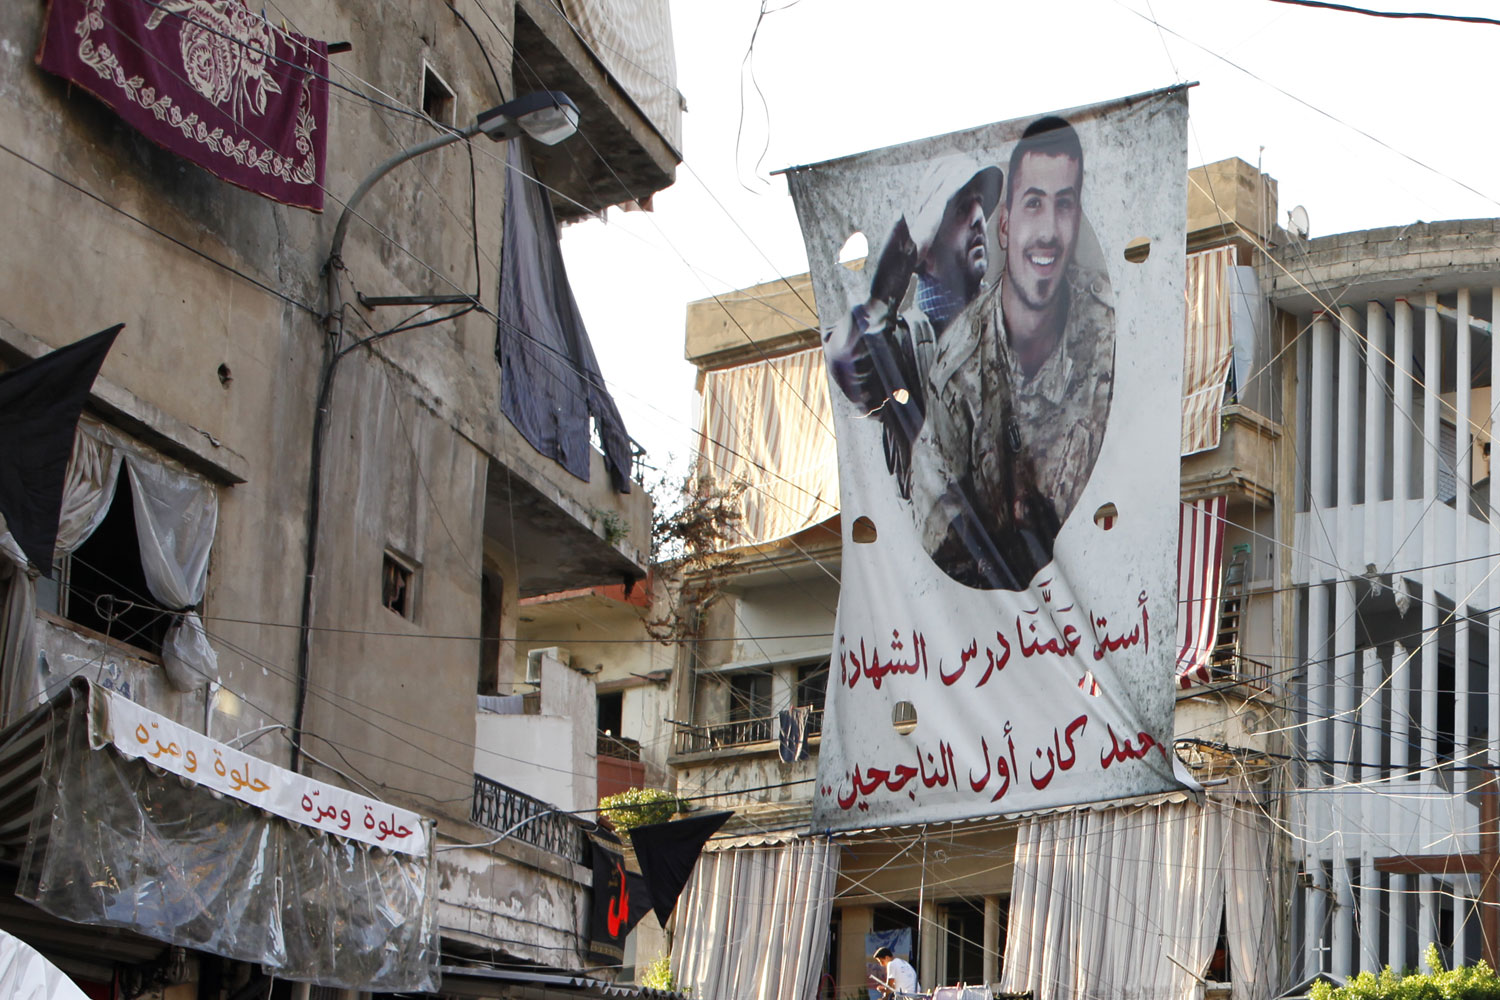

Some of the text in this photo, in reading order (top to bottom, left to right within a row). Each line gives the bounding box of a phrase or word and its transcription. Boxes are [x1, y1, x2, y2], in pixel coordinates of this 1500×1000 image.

[841, 629, 927, 690] الشهادة
[940, 631, 1011, 688] درس
[214, 748, 271, 793] حلوة
[969, 720, 1018, 802] أول
[1030, 715, 1088, 790] كان
[363, 805, 413, 841] حلوة
